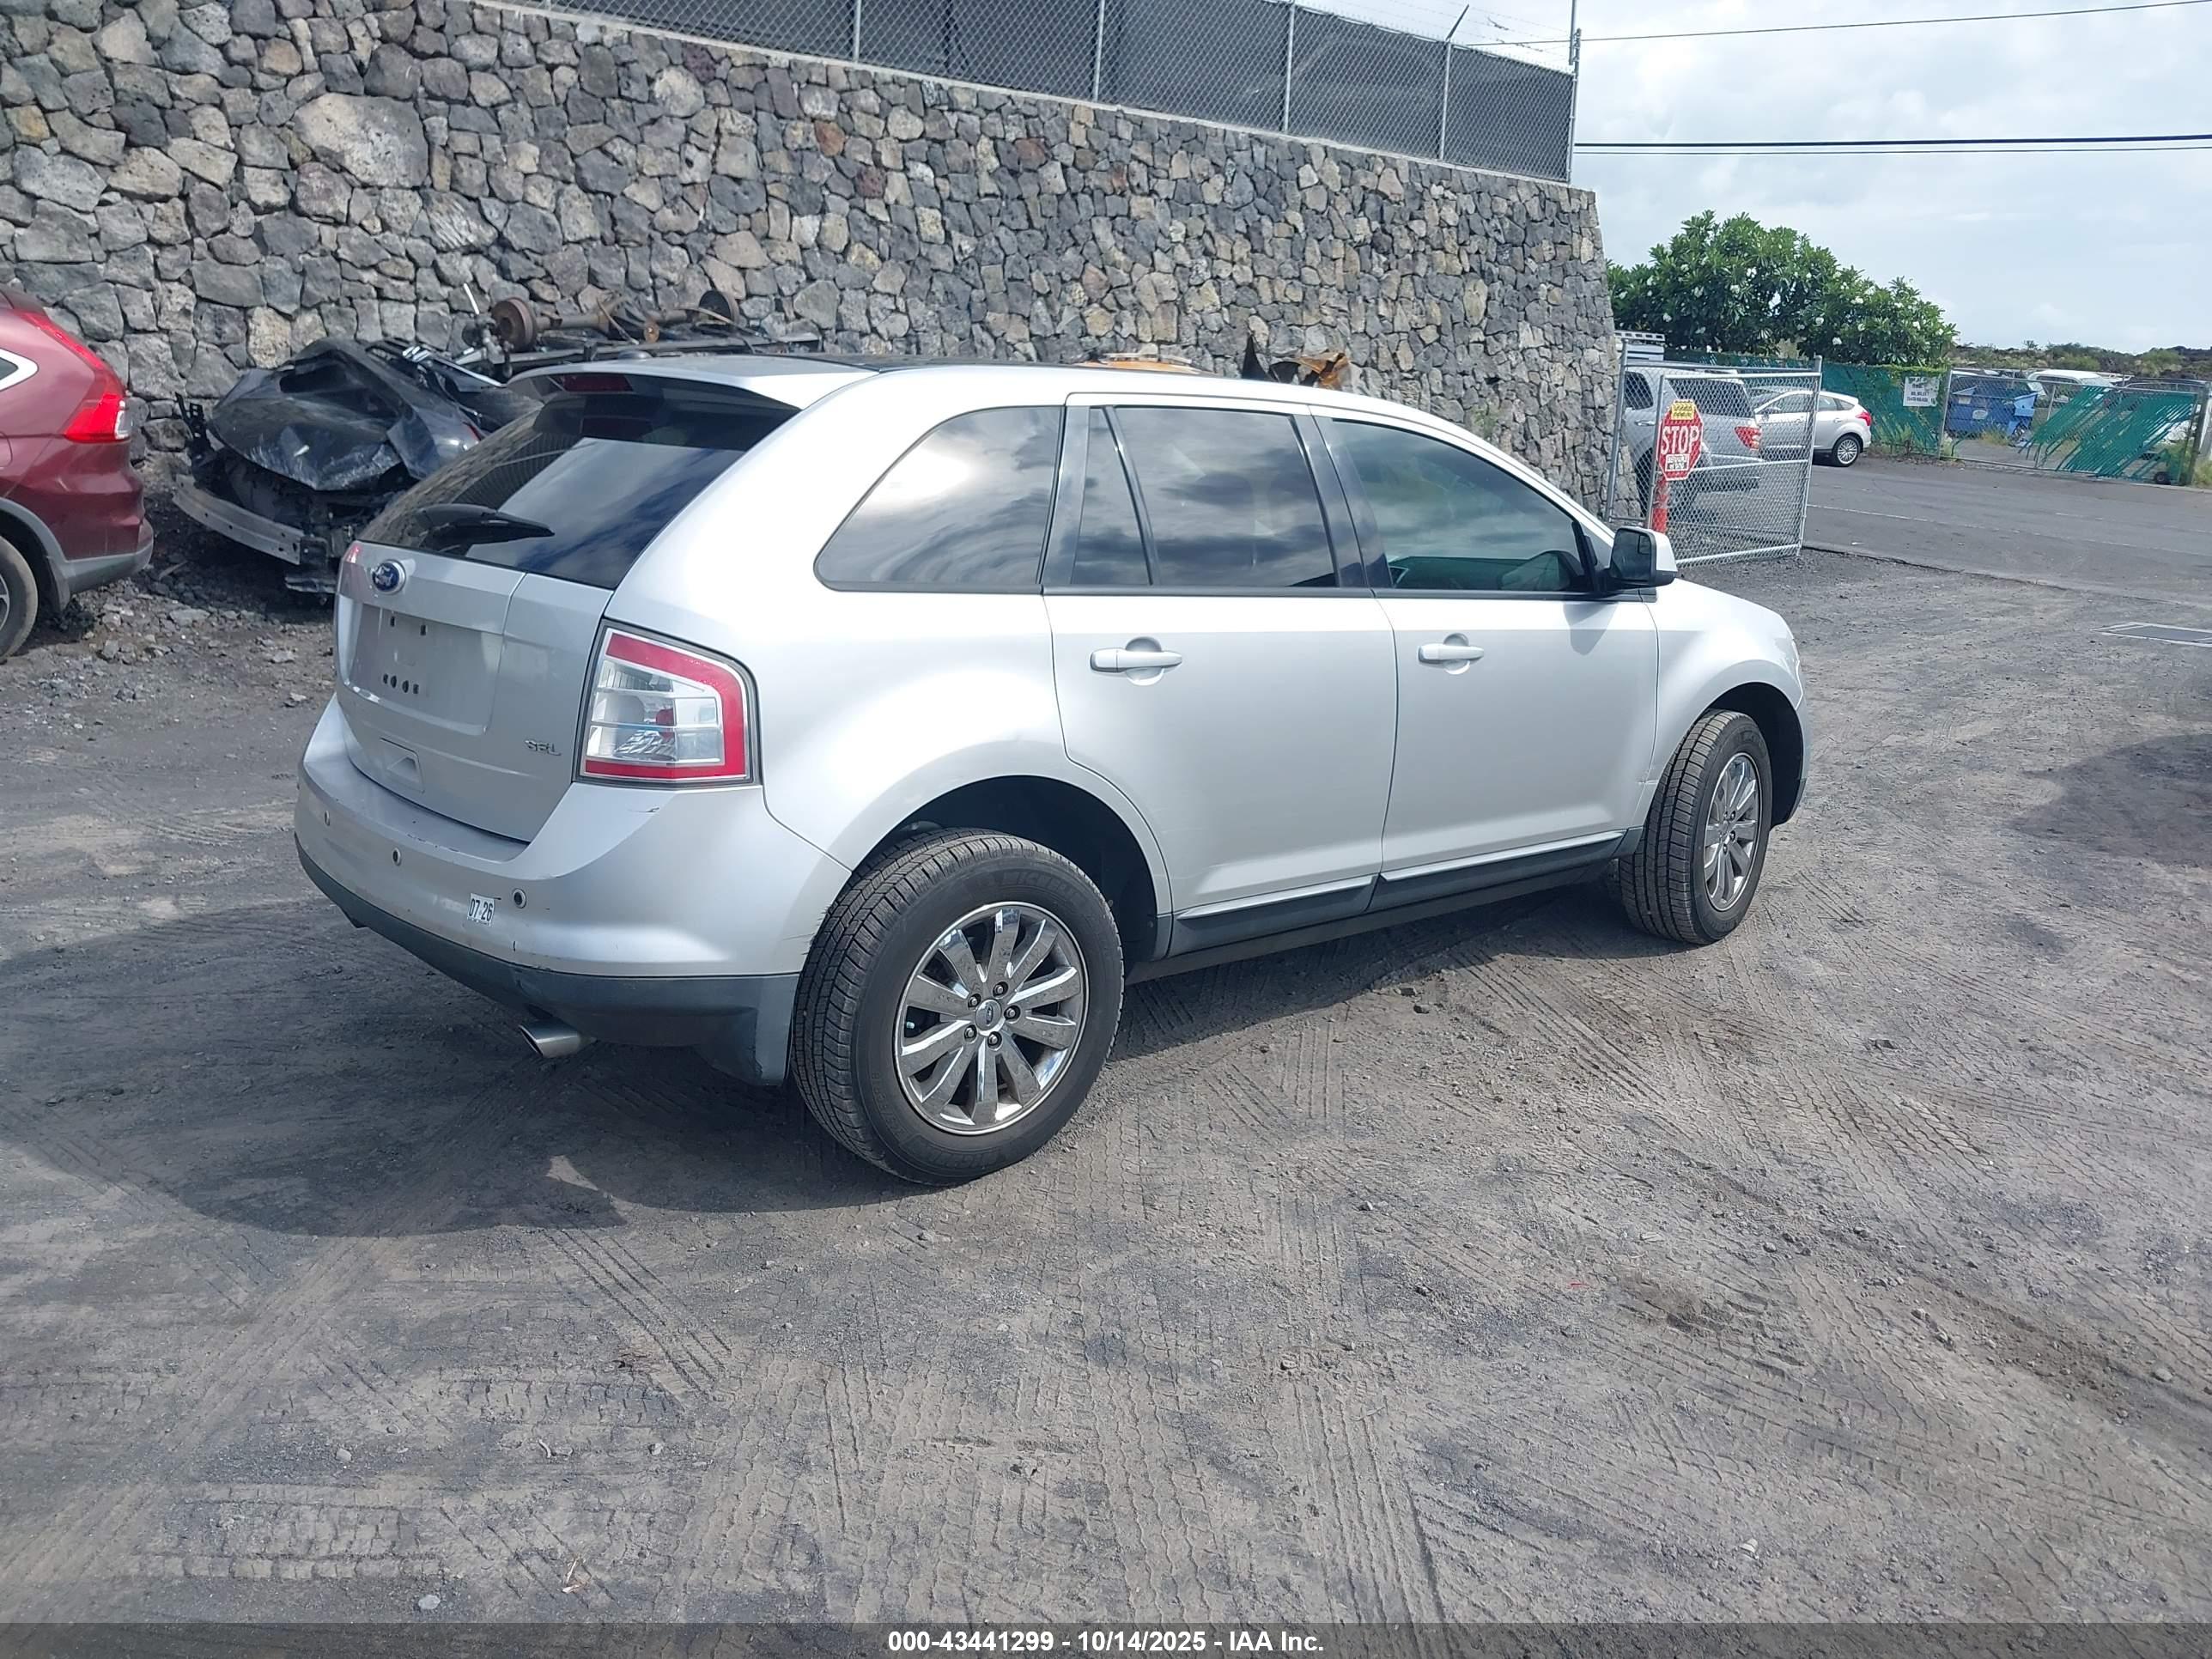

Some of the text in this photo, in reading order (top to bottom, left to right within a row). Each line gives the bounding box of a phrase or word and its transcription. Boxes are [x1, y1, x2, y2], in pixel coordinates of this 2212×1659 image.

[1661, 425, 1699, 455] STOP
[469, 898, 493, 921] 07 26
